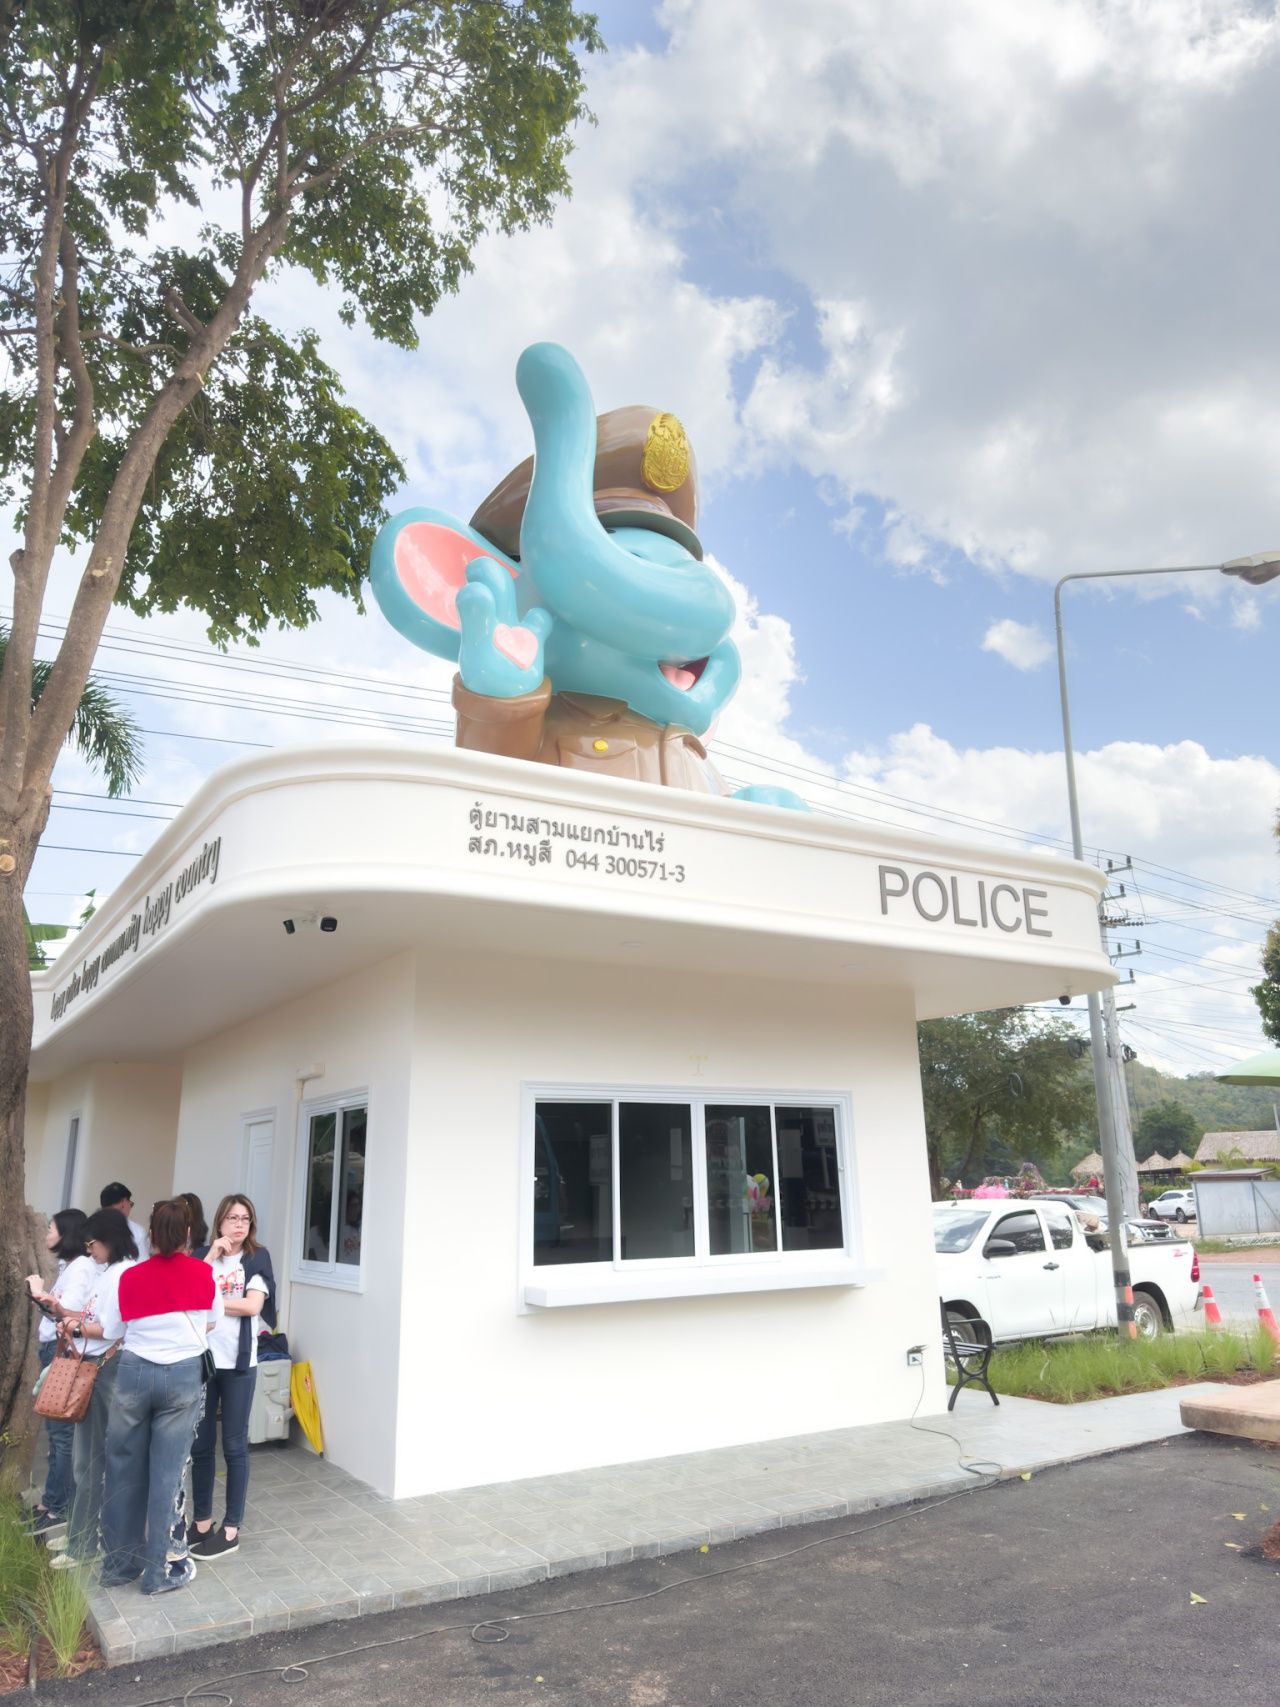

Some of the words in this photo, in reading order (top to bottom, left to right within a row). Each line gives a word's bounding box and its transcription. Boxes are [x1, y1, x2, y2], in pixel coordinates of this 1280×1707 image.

[469, 801, 666, 853] ตู้ยามสามแยกบ้านไร่
[142, 882, 173, 935] happy
[175, 836, 222, 904] country
[468, 835, 552, 867] สภ.หมูสี
[565, 848, 600, 872] 044
[604, 854, 686, 883] 300571-3
[878, 864, 1053, 937] POLICE
